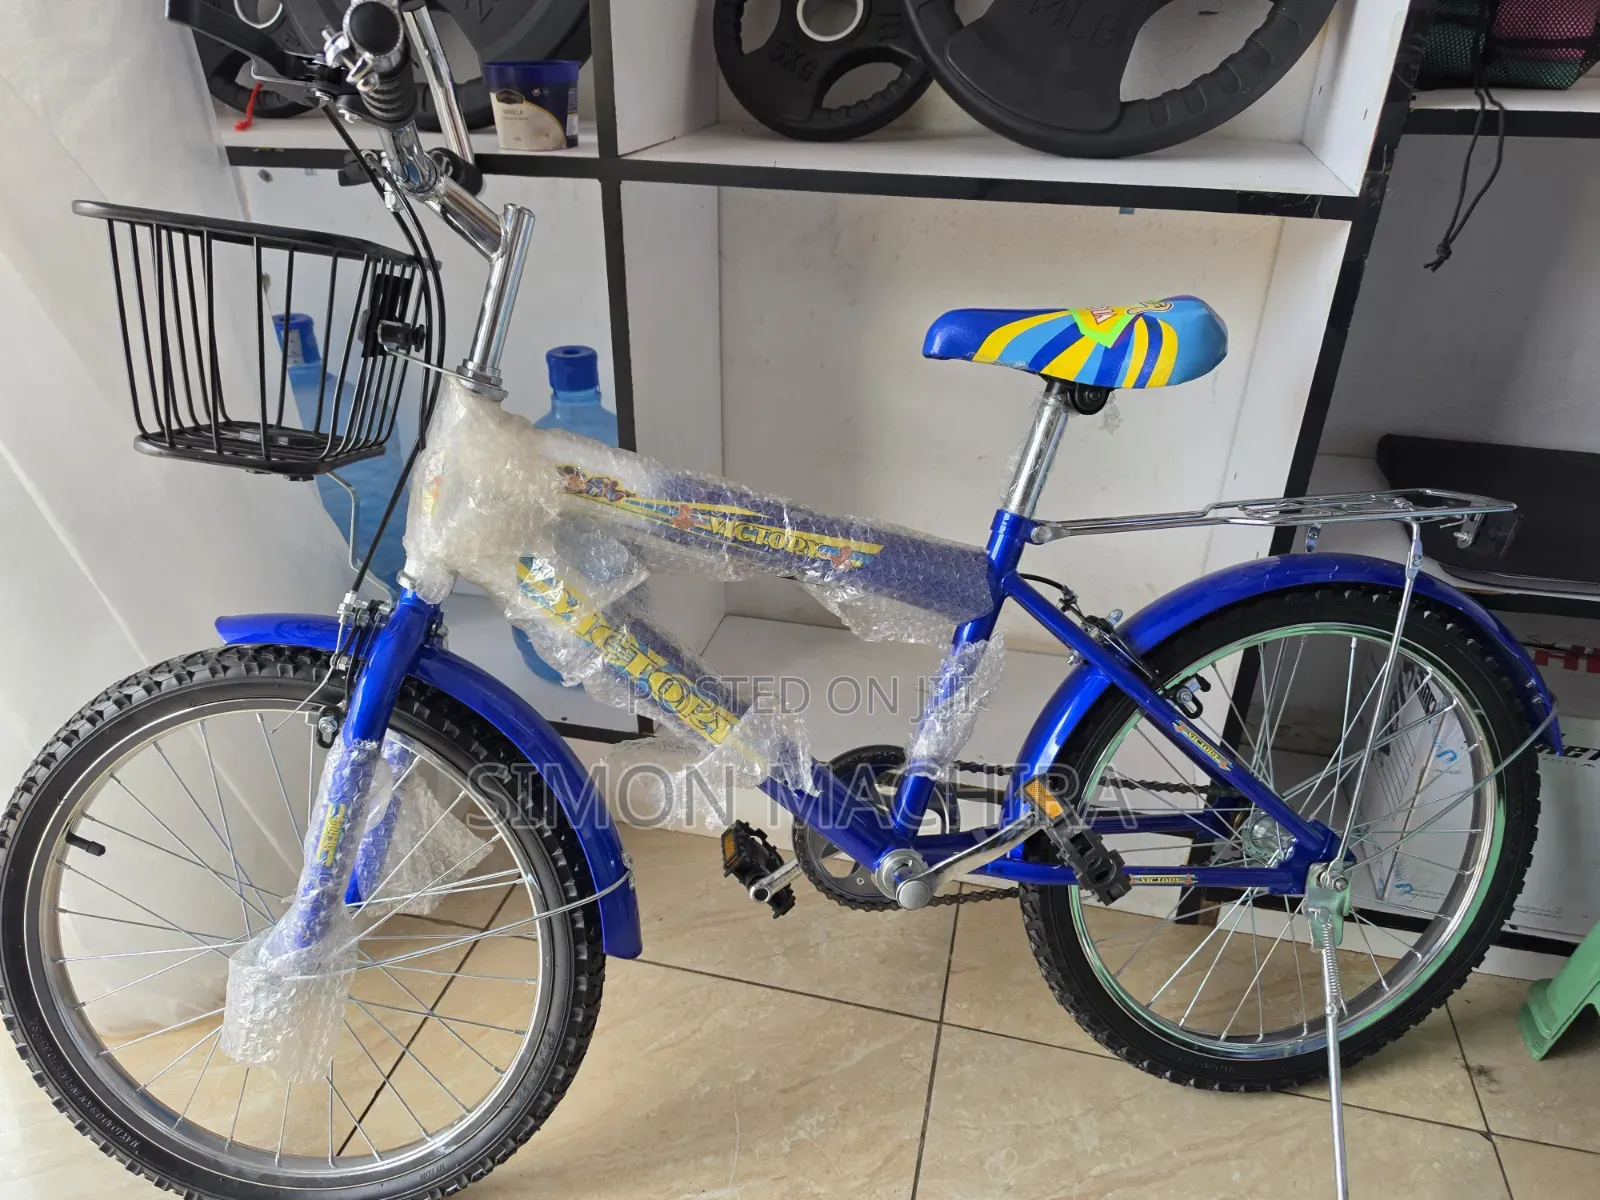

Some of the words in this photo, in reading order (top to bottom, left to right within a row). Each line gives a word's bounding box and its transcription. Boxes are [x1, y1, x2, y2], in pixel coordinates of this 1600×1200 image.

[502, 108, 524, 116] VANILLA
[709, 516, 823, 559] VICTORY
[1186, 731, 1220, 761] VICTORY
[1140, 876, 1181, 884] VICTORY
